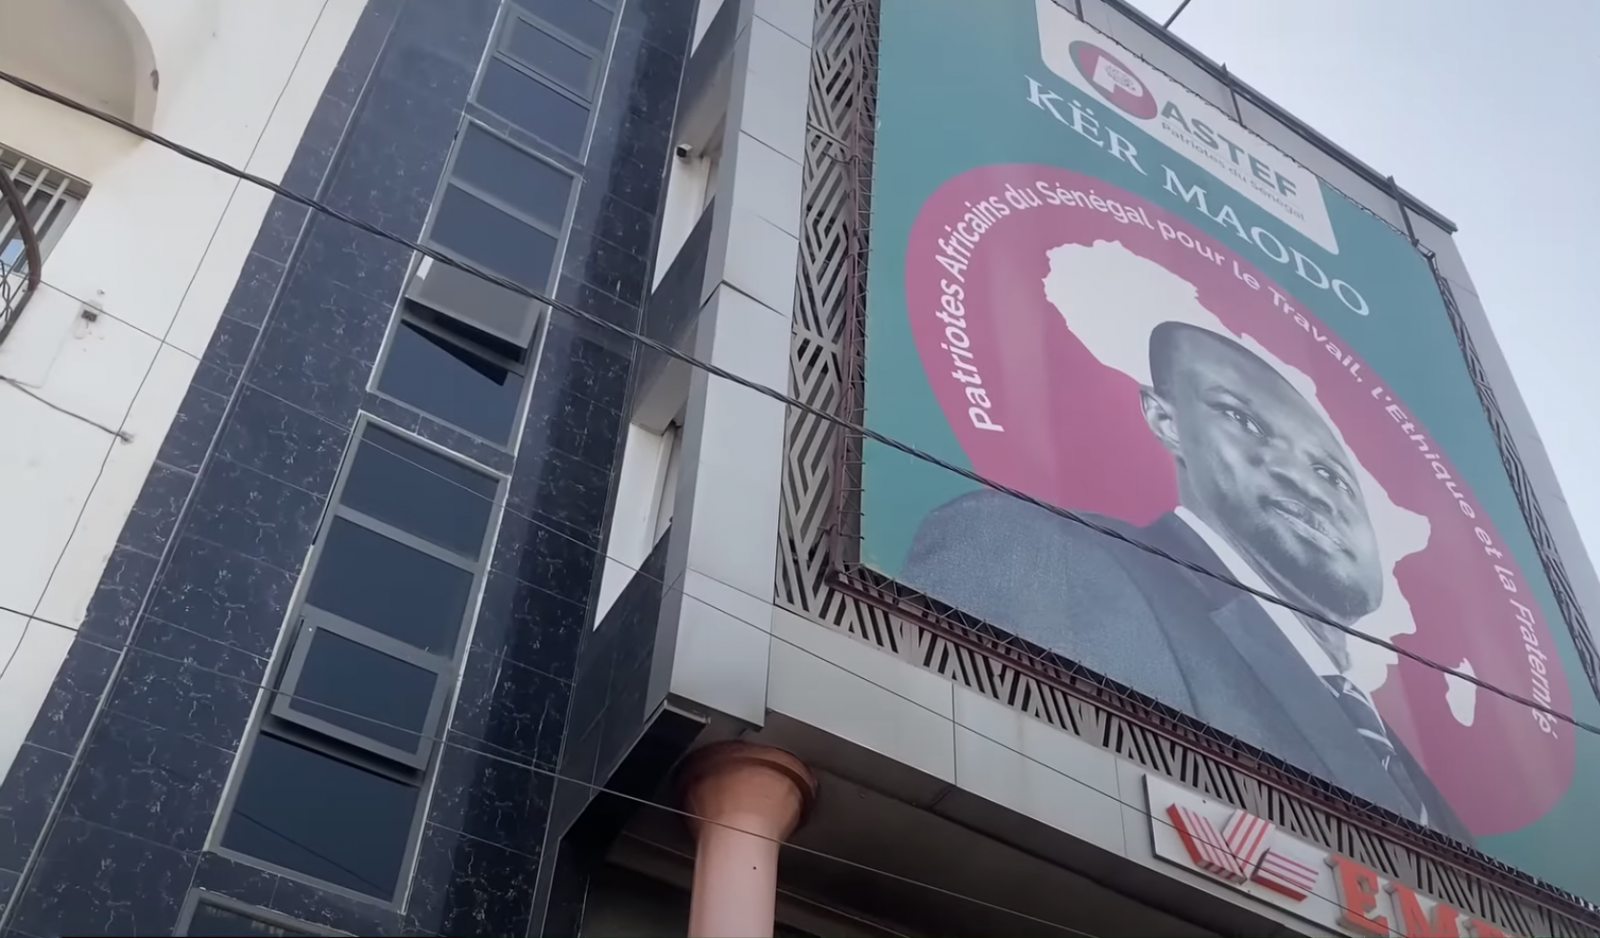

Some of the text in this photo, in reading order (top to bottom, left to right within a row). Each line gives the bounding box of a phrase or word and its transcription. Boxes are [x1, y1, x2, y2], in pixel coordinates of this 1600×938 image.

[1161, 121, 1226, 170] Patriotes
[1228, 167, 1247, 185] du
[1005, 183, 1043, 210] du
[1024, 74, 1369, 316] KËR MAODO
[1035, 181, 1155, 230] Sénégal
[935, 195, 1011, 283] Africains
[1157, 219, 1225, 266] pour
[1232, 260, 1261, 291] le
[935, 278, 1005, 433] Patriotes
[1268, 286, 1363, 383] Travail,
[1474, 526, 1503, 558] et
[1494, 563, 1518, 594] la
